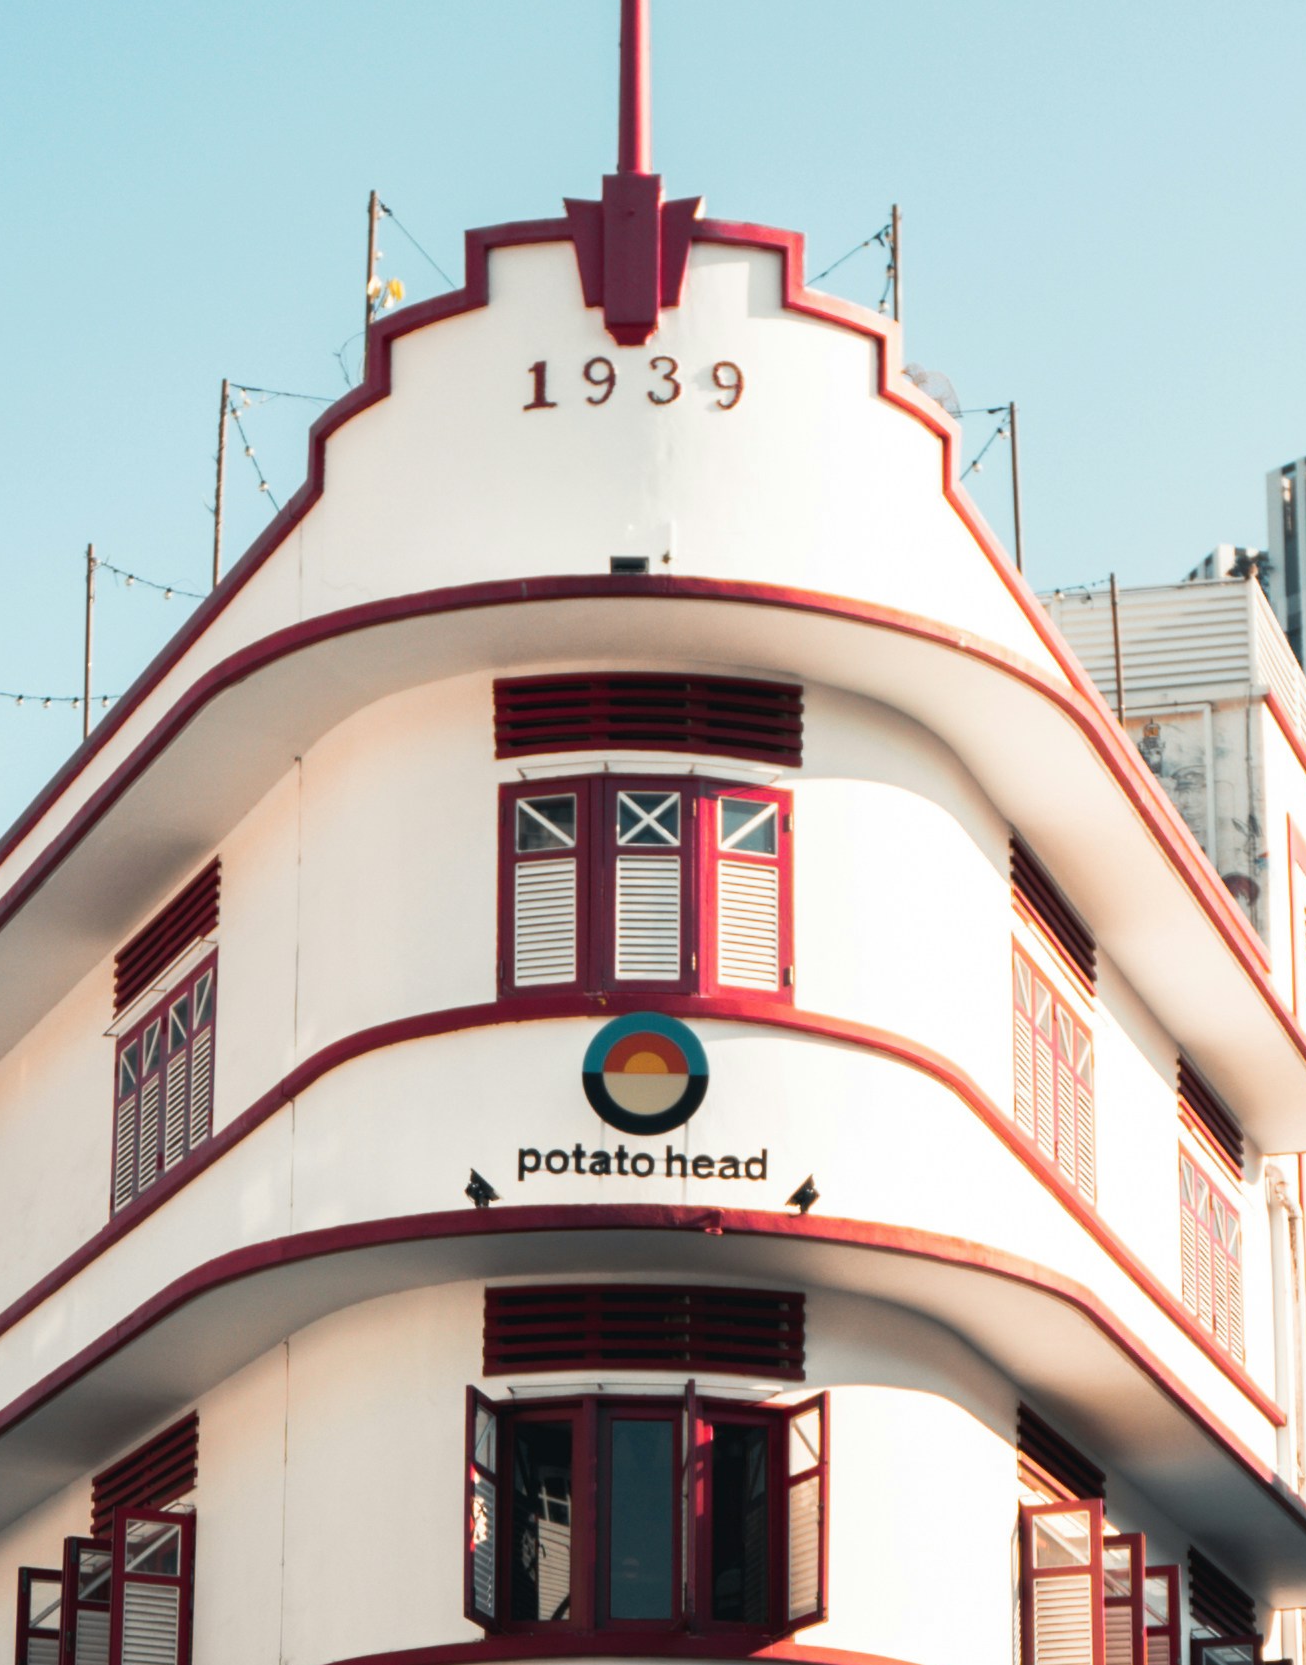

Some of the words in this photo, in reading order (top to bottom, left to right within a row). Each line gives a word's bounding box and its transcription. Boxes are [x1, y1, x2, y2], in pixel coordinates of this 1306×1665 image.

[522, 356, 745, 411] 1939
[517, 1143, 655, 1181] potato
[665, 1144, 768, 1182] head
